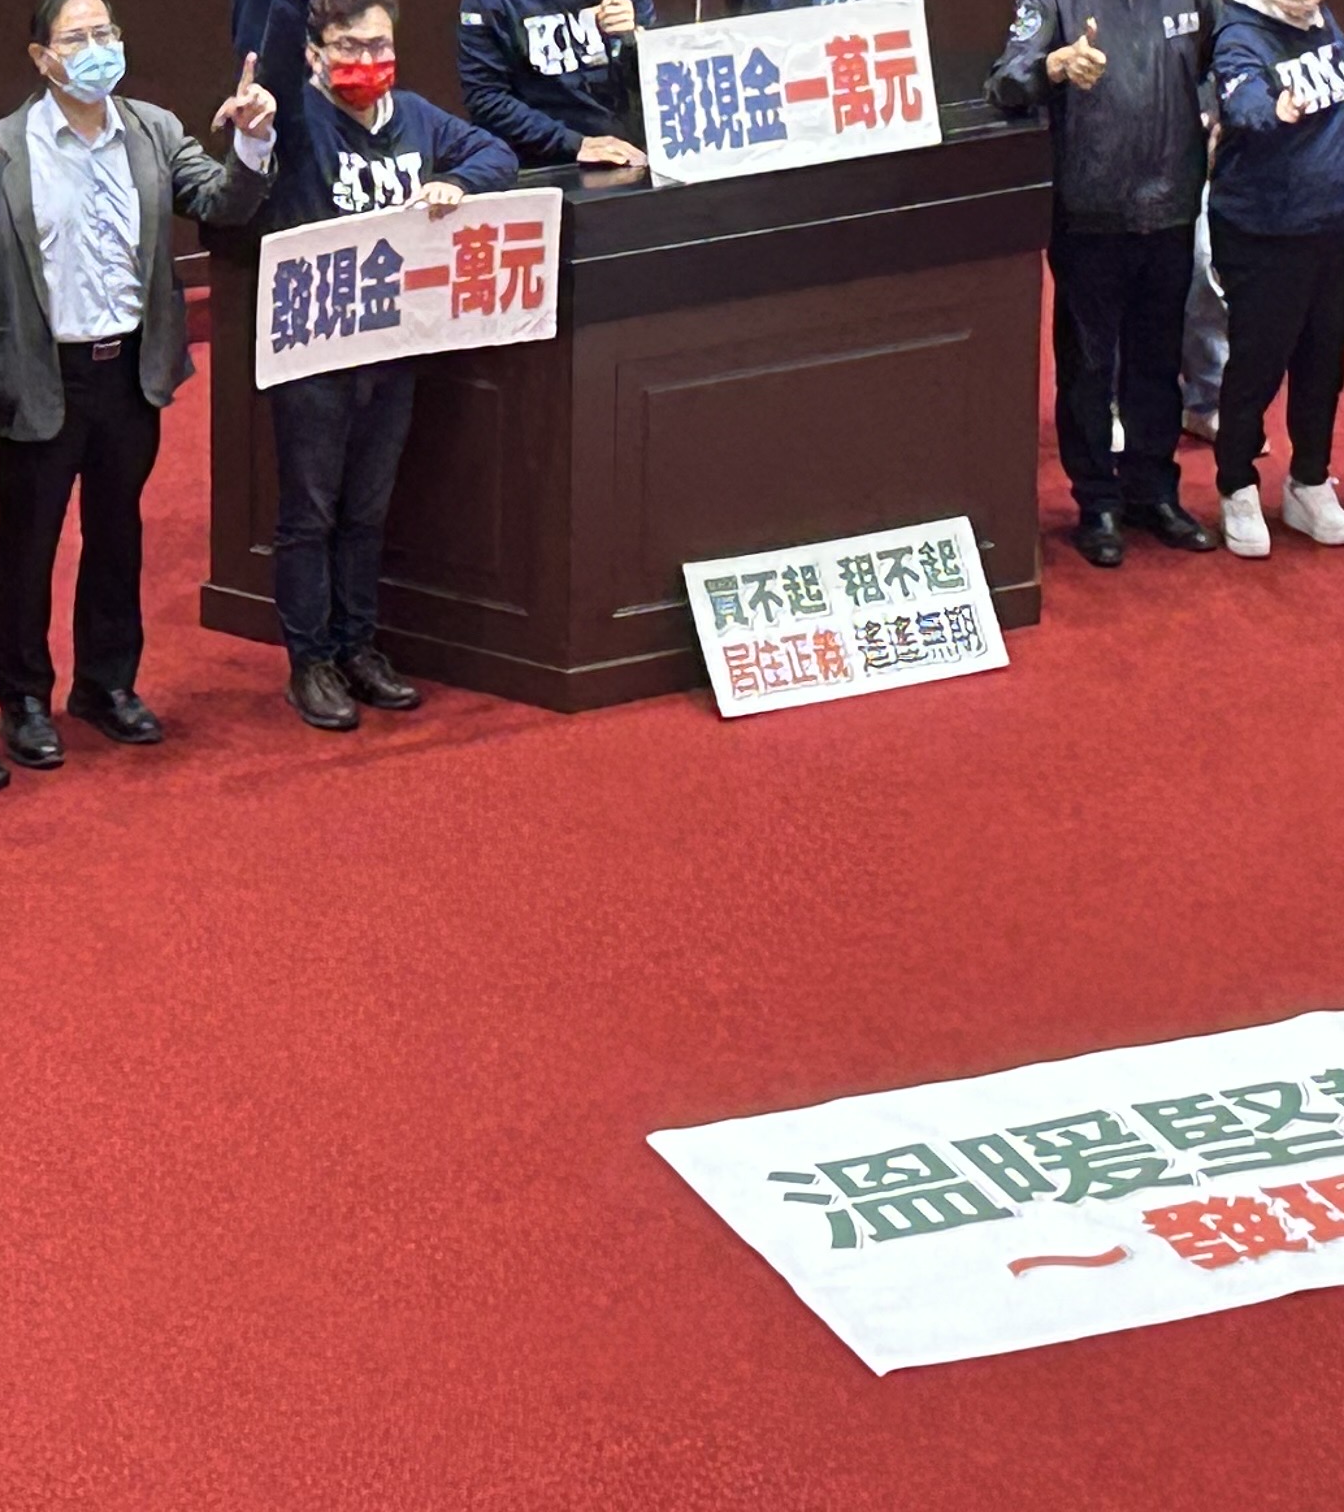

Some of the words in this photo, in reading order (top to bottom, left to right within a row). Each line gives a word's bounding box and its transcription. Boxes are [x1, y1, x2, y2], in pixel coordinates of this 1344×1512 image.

[522, 7, 610, 76] KM
[655, 29, 924, 157] 發現金一萬元
[270, 220, 546, 355] 發現金一萬元
[704, 563, 827, 630] 買不起
[837, 538, 965, 607] 租不起
